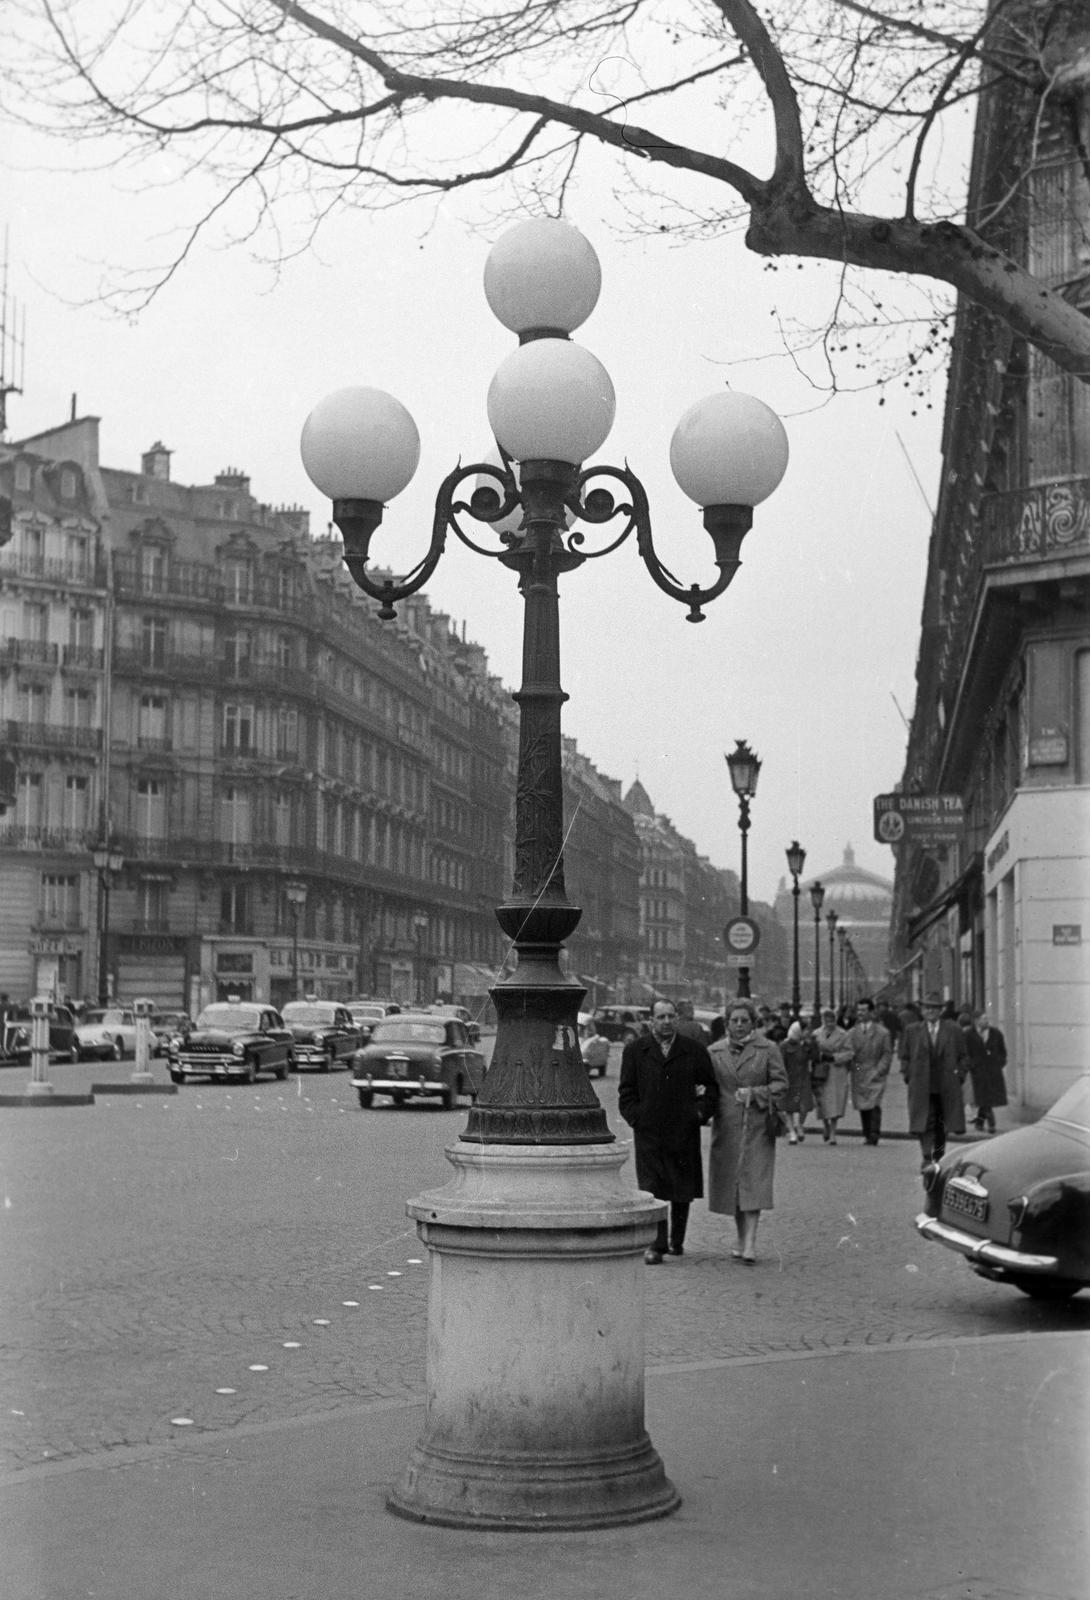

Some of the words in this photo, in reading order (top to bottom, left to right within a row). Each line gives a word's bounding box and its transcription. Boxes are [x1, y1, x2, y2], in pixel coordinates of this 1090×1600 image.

[876, 799, 893, 810] THE
[899, 798, 939, 810] DANISH
[942, 796, 963, 810] TEA
